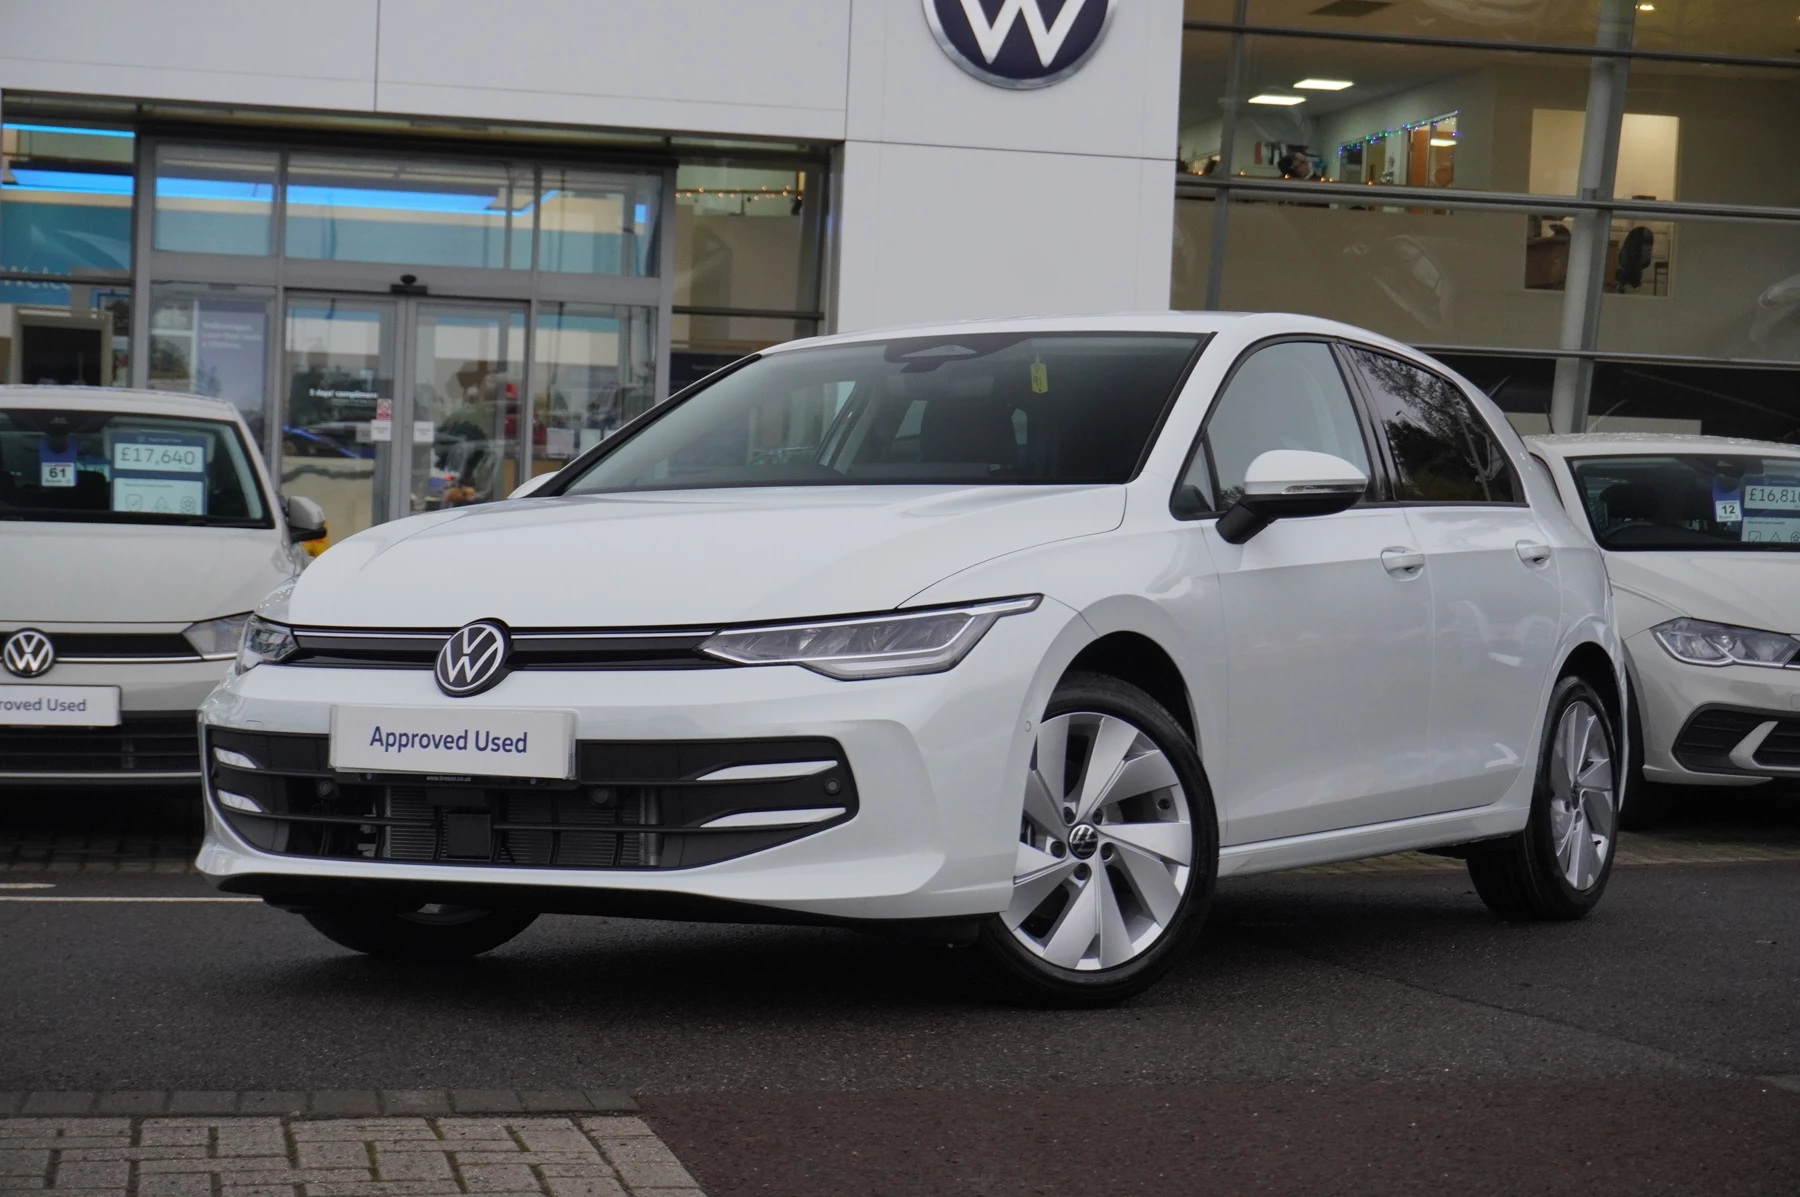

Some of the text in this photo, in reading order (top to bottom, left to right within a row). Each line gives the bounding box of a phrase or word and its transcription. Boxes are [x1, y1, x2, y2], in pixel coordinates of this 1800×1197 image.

[121, 446, 195, 466] £17,640
[49, 467, 66, 478] 61
[1749, 488, 1800, 504] £16,81
[1722, 505, 1736, 515] 12
[47, 699, 87, 711] Used
[370, 726, 528, 753] Approved Used
